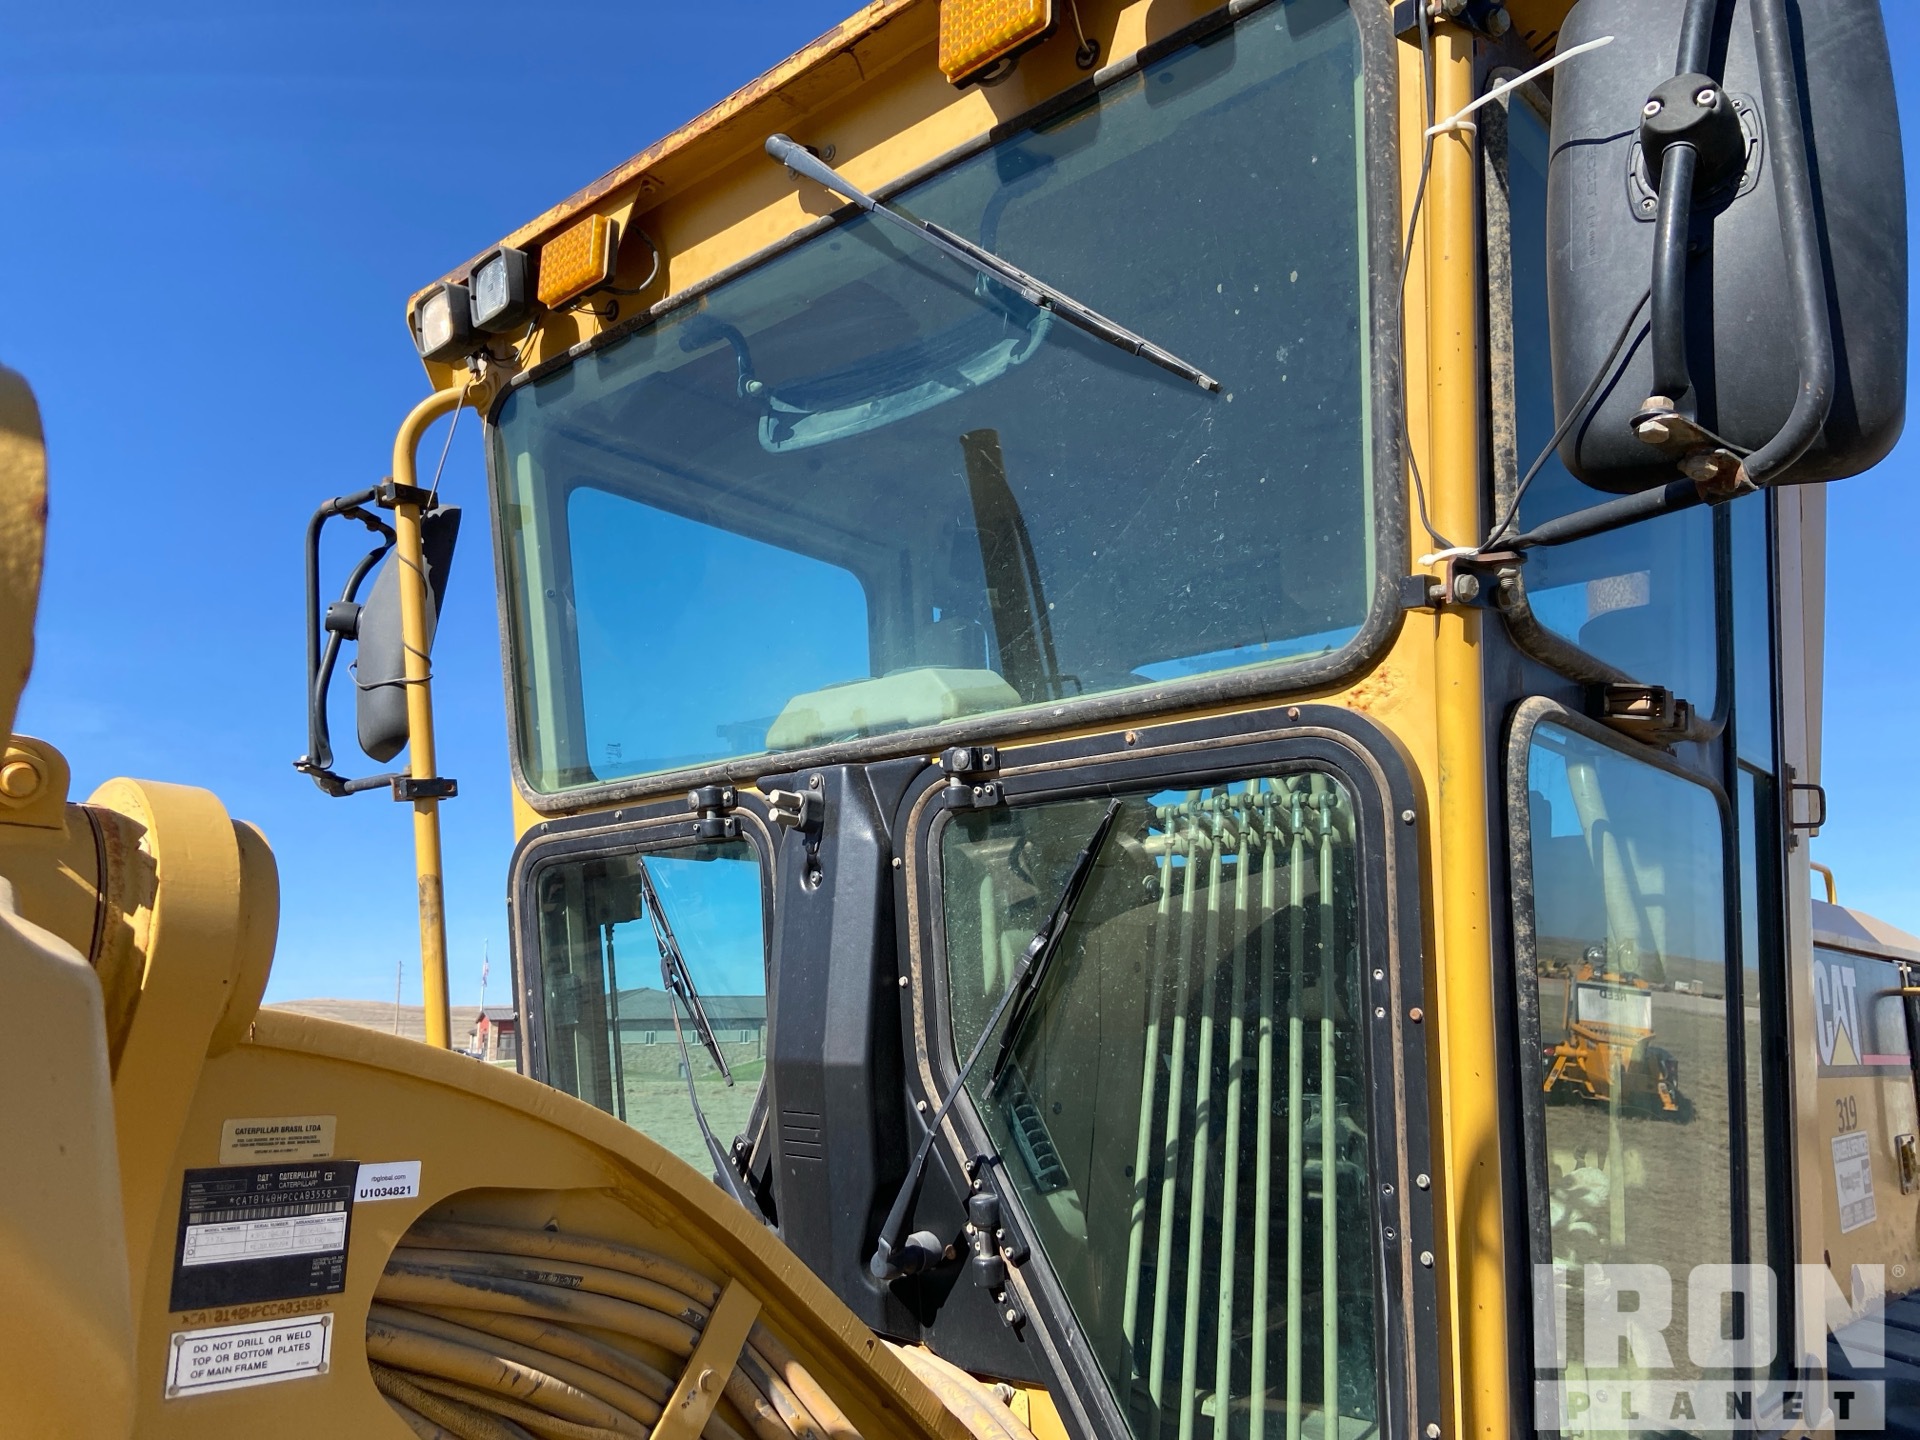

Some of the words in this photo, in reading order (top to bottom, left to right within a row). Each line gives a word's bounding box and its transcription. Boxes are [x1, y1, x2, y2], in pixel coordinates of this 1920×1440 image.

[1814, 959, 1862, 1066] CAT
[1836, 1095, 1857, 1133] 319
[235, 1126, 279, 1135] CATERPILLAR
[281, 1125, 303, 1133] BRASIL
[305, 1124, 321, 1132] LTDA
[257, 1173, 270, 1182] CAT
[279, 1171, 318, 1181] CATERPILLAR
[371, 1174, 406, 1182] rbglobal.com
[278, 1180, 317, 1189] CATERPILLAR
[360, 1186, 411, 1198] U1034821
[193, 1344, 208, 1354] DO
[212, 1341, 233, 1351] NOT
[236, 1338, 264, 1348] DRILL
[268, 1334, 282, 1343] OR
[286, 1330, 312, 1341] WELD
[192, 1356, 212, 1366] TOP
[215, 1354, 230, 1363] OR
[234, 1348, 273, 1360] BOTTOM
[277, 1342, 310, 1354] PLATES
[190, 1369, 204, 1379] OF
[206, 1366, 232, 1377] MAIN
[234, 1360, 268, 1372] FRAME
